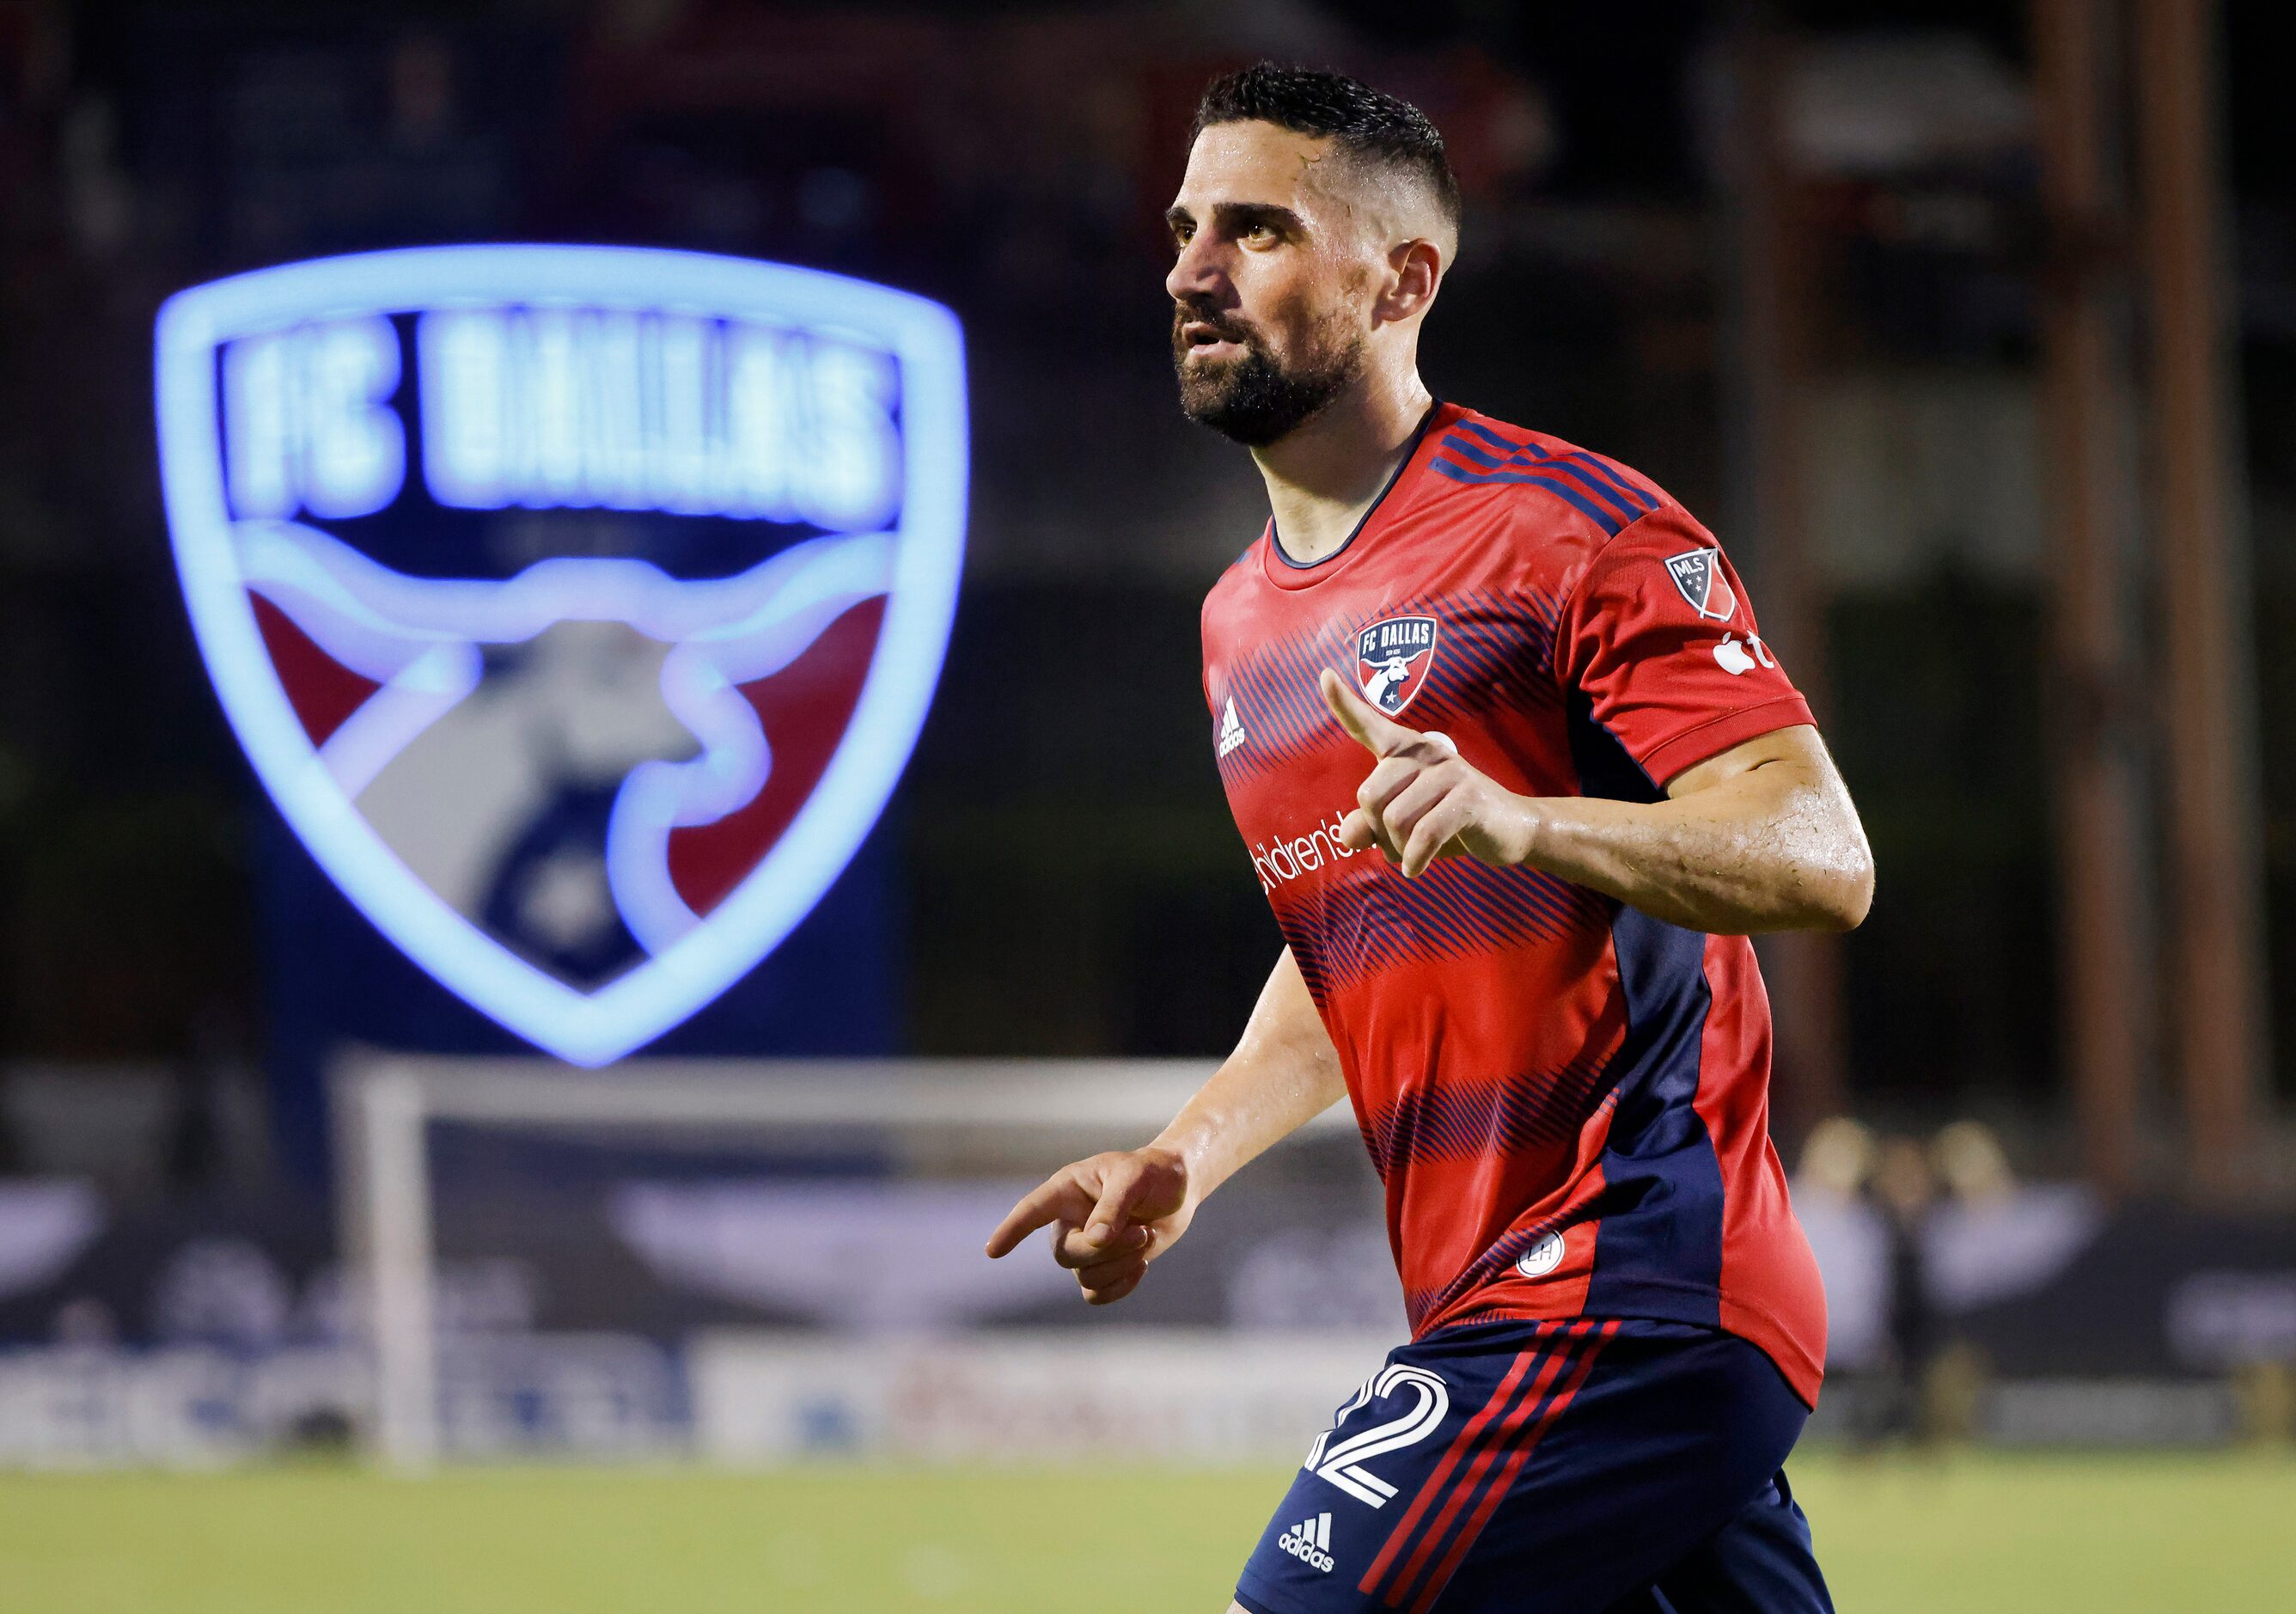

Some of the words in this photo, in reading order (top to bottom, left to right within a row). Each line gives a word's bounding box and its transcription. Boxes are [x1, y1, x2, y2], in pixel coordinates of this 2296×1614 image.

[223, 313, 406, 521] FC
[418, 308, 902, 530] DALLAS
[1673, 557, 1705, 578] MLS
[1362, 630, 1377, 655] FC
[1381, 622, 1429, 647] DALLAS
[1219, 727, 1245, 759] adidas
[1249, 818, 1354, 896] hildren's
[1277, 1532, 1334, 1573] adidas
